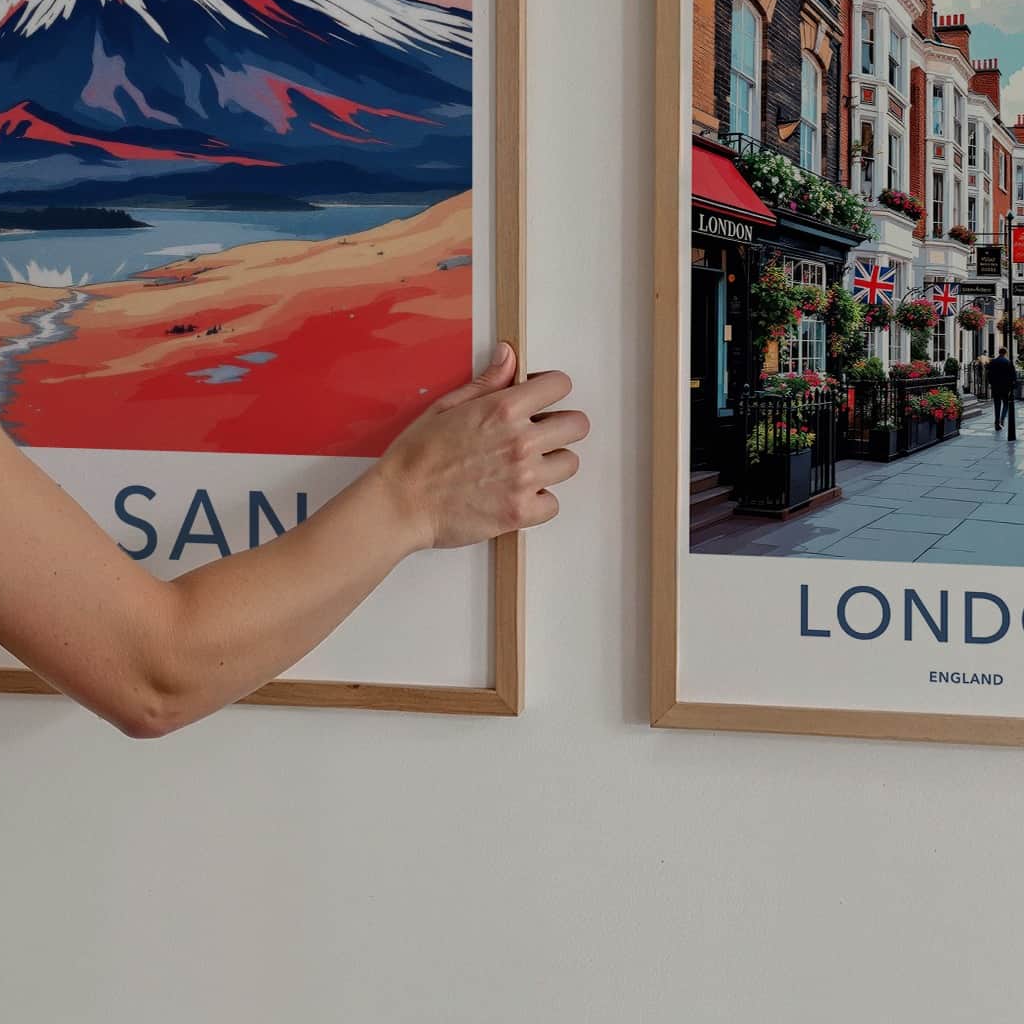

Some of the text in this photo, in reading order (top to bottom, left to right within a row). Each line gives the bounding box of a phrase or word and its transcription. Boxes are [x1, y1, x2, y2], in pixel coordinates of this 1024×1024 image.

[698, 213, 753, 242] LONDON
[800, 583, 1024, 645] LOND
[929, 671, 1004, 686] ENGLAND
